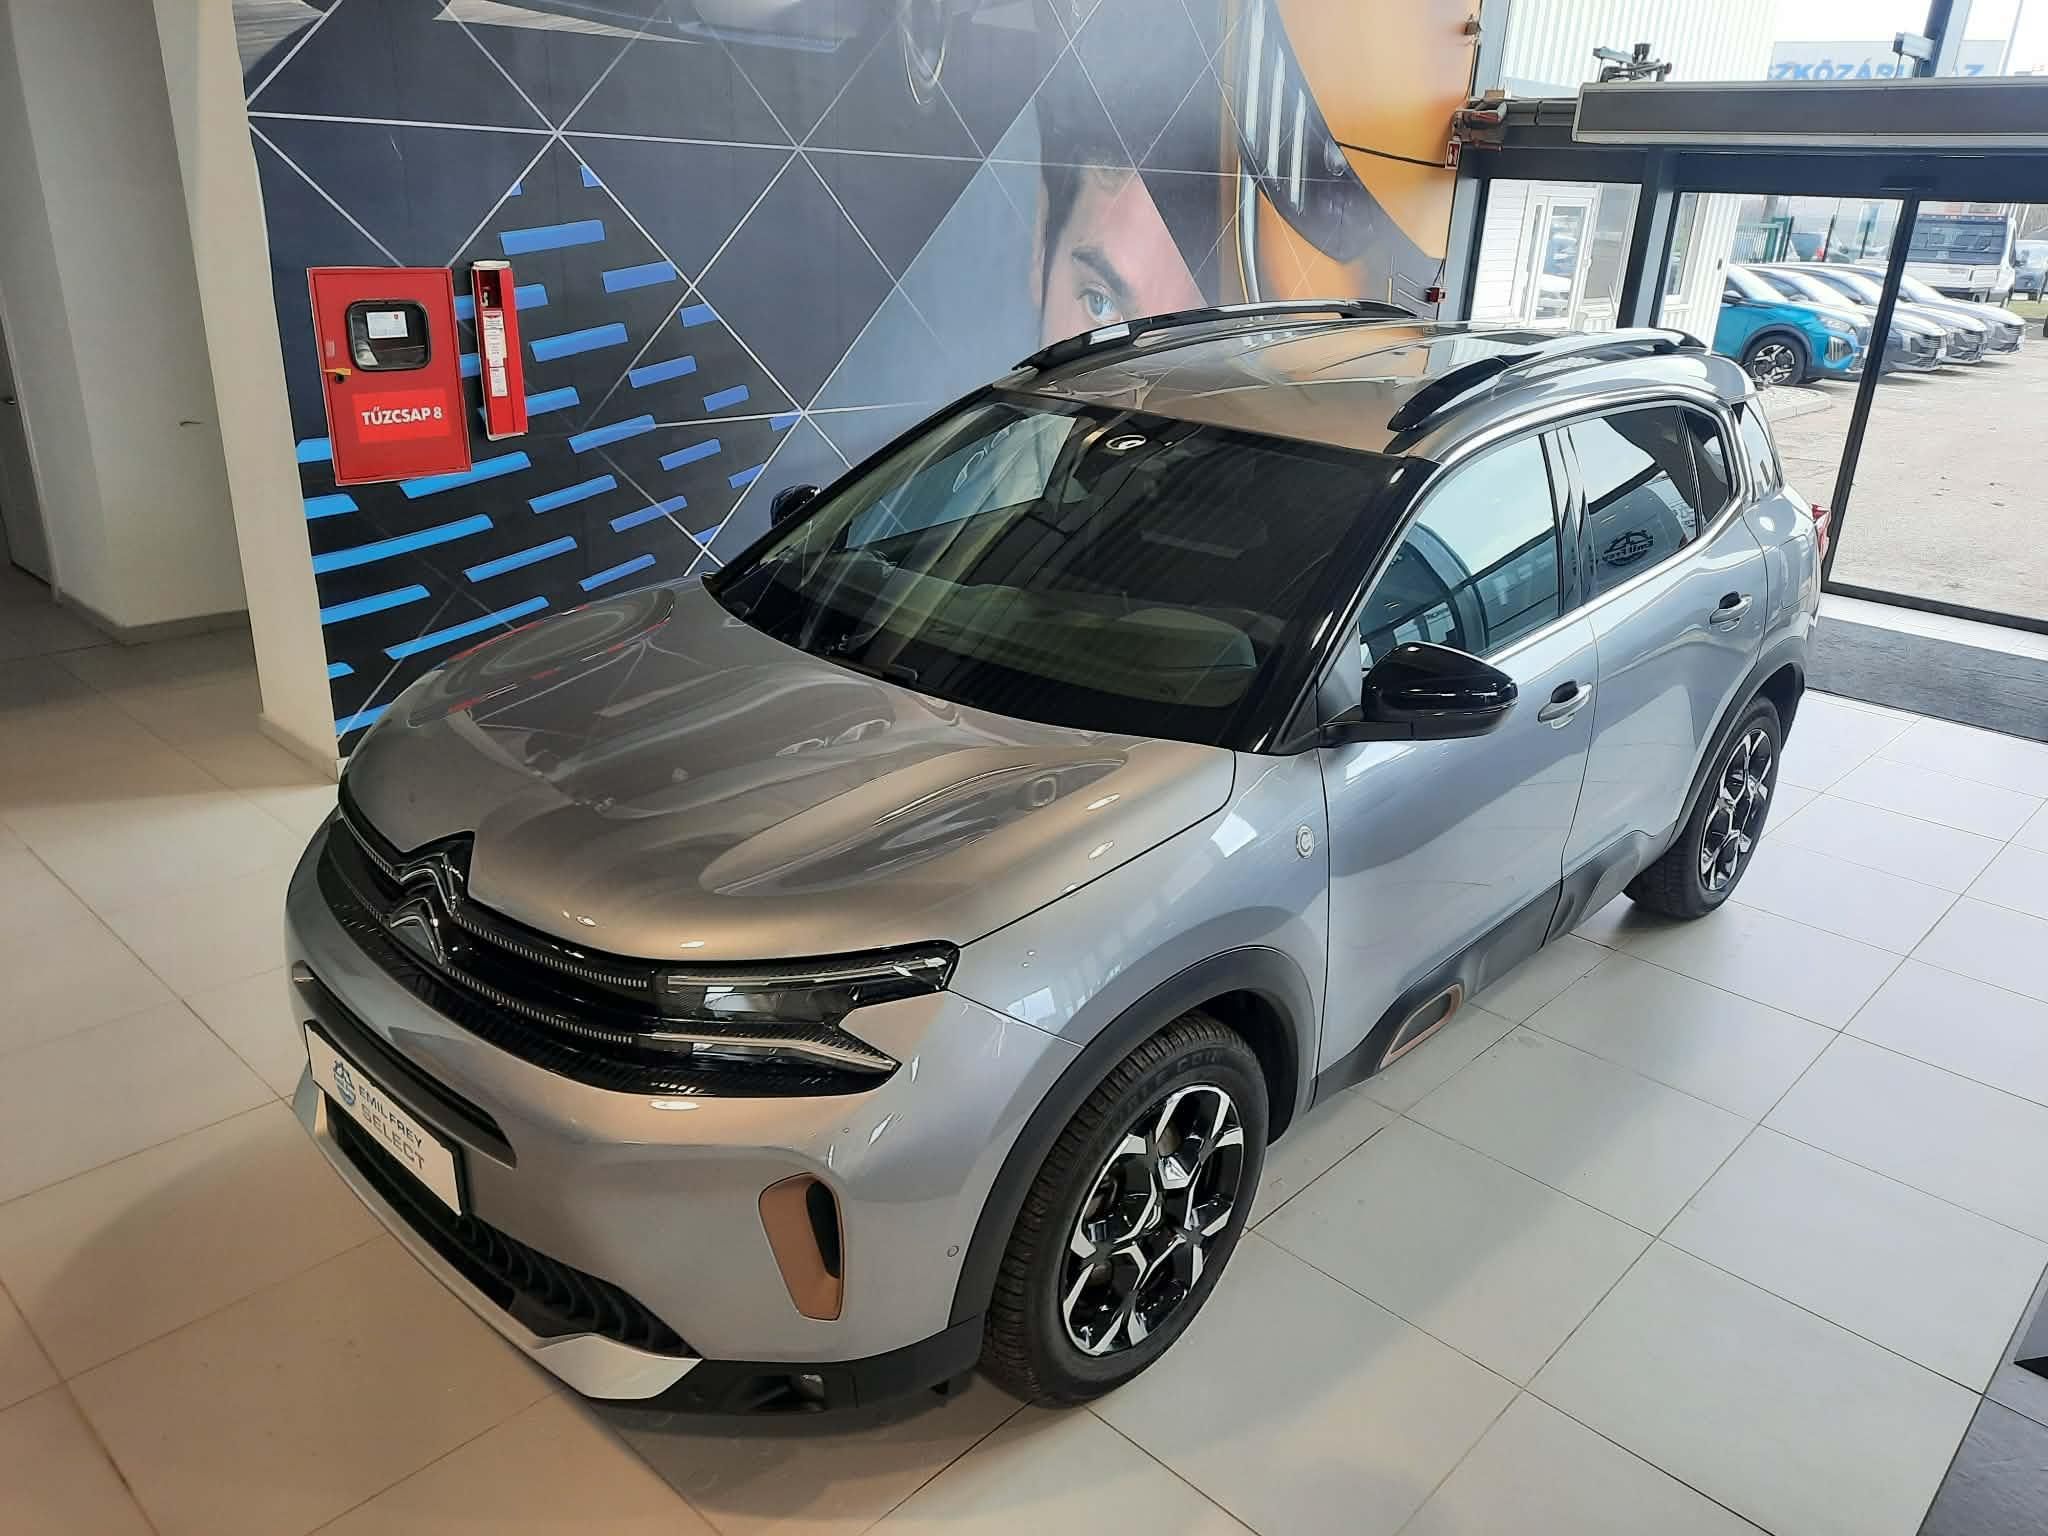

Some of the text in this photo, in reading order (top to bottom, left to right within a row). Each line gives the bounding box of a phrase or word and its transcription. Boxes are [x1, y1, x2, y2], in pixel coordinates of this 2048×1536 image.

[361, 406, 442, 425] TŰZCSAP 8
[361, 1103, 424, 1169] SELECT
